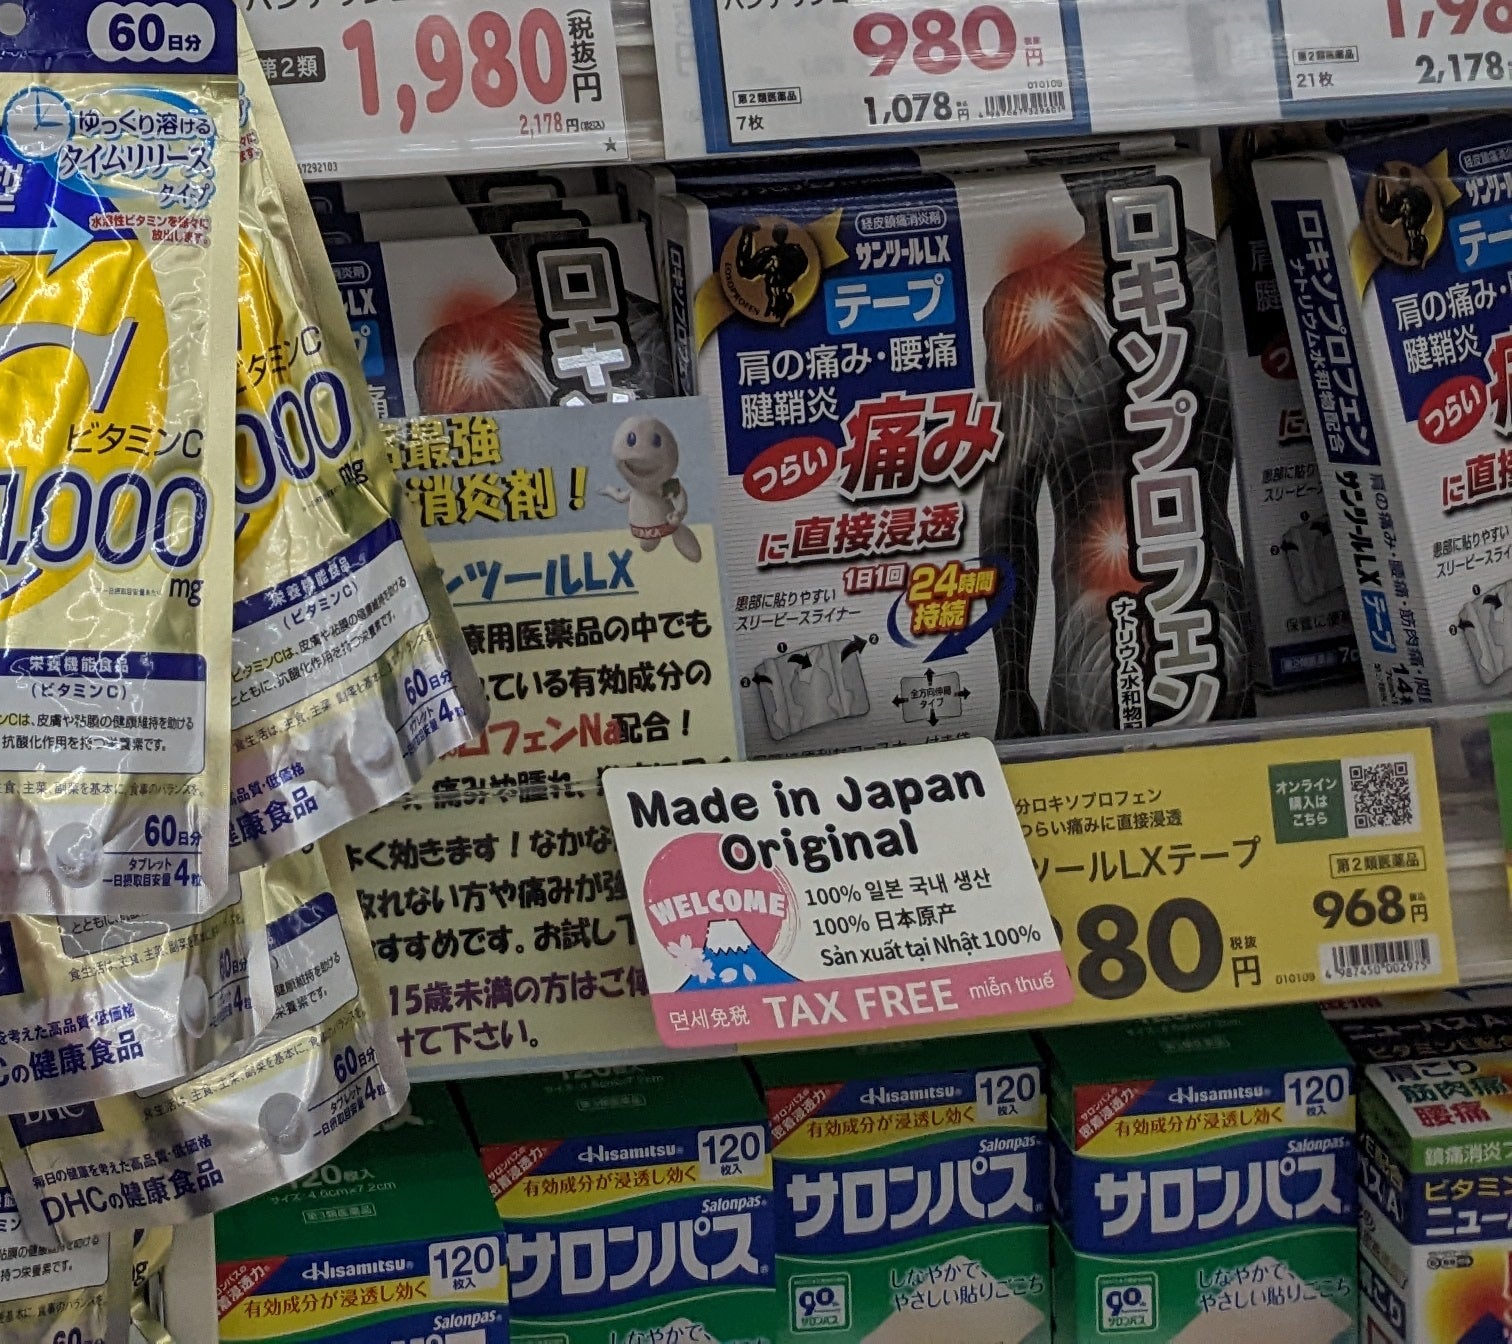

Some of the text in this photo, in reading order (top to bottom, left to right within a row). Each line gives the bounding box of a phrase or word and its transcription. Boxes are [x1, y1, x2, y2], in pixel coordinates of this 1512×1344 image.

[108, 14, 202, 52] 60日分
[853, 5, 1016, 76] 980
[342, 8, 567, 134] 1,980
[1297, 72, 1333, 88] 21枚
[79, 113, 211, 134] ゆっくり溶ける
[736, 114, 764, 131] 7枚
[160, 184, 213, 206] タイプ
[856, 235, 951, 270] サンツールLX
[835, 273, 944, 329] テープ
[737, 333, 957, 386] 肩の痛み・腰痛
[1404, 324, 1481, 375] 腱鞘炎
[741, 387, 839, 429] 腱鞘炎
[1425, 389, 1482, 440] つらい
[66, 424, 203, 456] ビタミンC
[838, 393, 1002, 502] 痛み
[750, 448, 830, 491] つらい
[757, 501, 963, 562] に直接浸透
[736, 589, 836, 611] 患部に貼りやすい
[30, 656, 129, 673] 栄養機能食品
[627, 769, 985, 828] Made in Japan
[1275, 776, 1337, 796] オンライン
[1289, 795, 1329, 811] 購入は
[1293, 811, 1328, 828] こちら
[144, 815, 202, 847] 60日分
[722, 819, 918, 873] Original
[128, 858, 172, 873] タブレット
[1336, 852, 1420, 875] 第2類医薬品
[805, 868, 992, 906] 100% 일본 국내 생산
[648, 888, 787, 927] WELCOME
[813, 903, 956, 937] 100% 日本原产
[1313, 884, 1406, 930] 968
[820, 926, 1041, 967] Sản xuất tại Nhật 100%
[763, 969, 1055, 1030] TAX FREE miễn thuế
[980, 1073, 1036, 1106] 120
[1289, 1074, 1345, 1106] 120
[808, 1106, 975, 1139] 有効成分が浸透し効く
[997, 1105, 1019, 1117] 枚入
[1115, 1107, 1283, 1137] 有効成分が浸透し効く
[1414, 1100, 1492, 1127] 腰痛
[702, 1132, 760, 1164] 120
[978, 1135, 1036, 1154] Salonpas
[1287, 1136, 1346, 1154] Salonpas
[523, 1165, 696, 1198] 有効成分が浸透し効く
[720, 1163, 743, 1176] 枚入
[40, 1158, 224, 1225] DHCの健康食品
[701, 1196, 761, 1214] Salonpas
[787, 1152, 1033, 1238] サロンパス
[1095, 1154, 1341, 1237] サロンパス
[434, 1243, 495, 1279] 120
[506, 1213, 759, 1298] サロンパス
[244, 1280, 428, 1319] 有効成分が浸透し効く
[452, 1278, 476, 1290] 枚入
[894, 1275, 1045, 1312] やさしい貼りごこち
[433, 1310, 497, 1330] Salonpas
